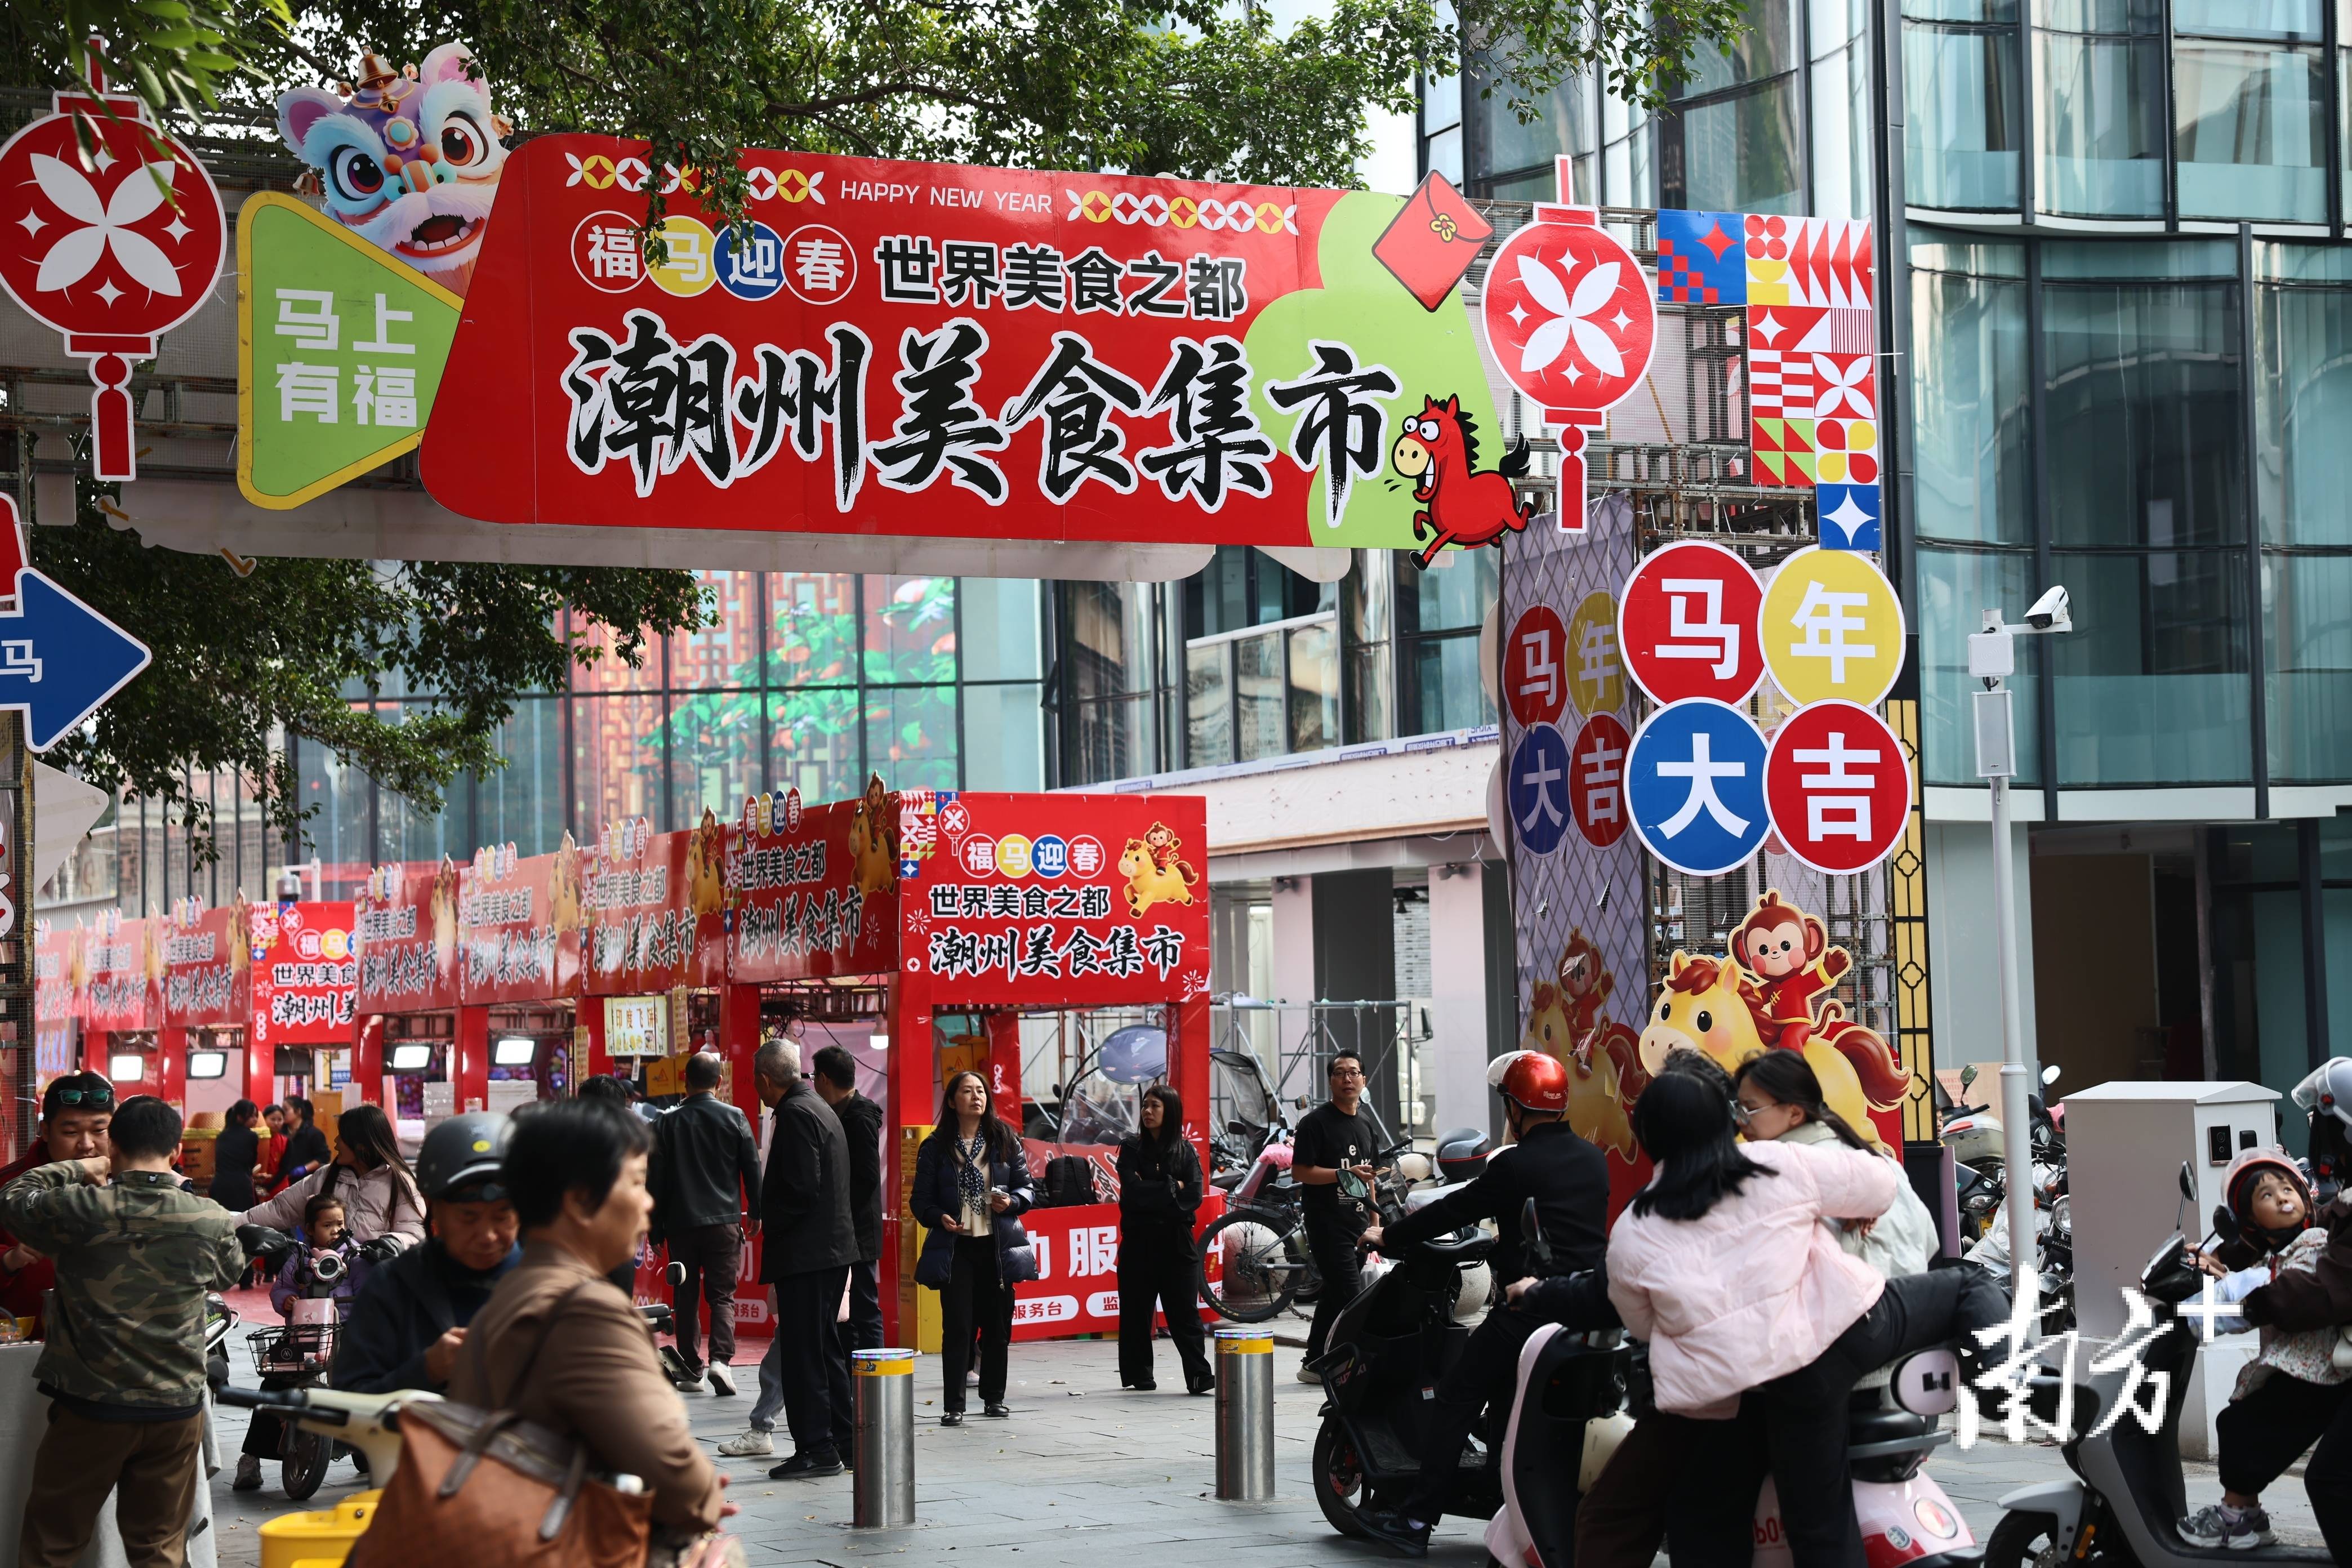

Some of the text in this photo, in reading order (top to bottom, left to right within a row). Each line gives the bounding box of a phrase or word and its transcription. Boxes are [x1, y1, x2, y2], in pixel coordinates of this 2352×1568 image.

[841, 180, 1052, 214] HAPPY NEW YEAR
[587, 224, 846, 293] 福马迎春
[874, 236, 1246, 321] 世界美食之都
[274, 288, 416, 354] 马上
[275, 362, 417, 427] 有福
[563, 310, 1401, 526] 潮州美食集市
[1655, 578, 1876, 684] 马年
[1519, 621, 1619, 707] 马年
[745, 794, 800, 832] 福马迎春
[1522, 738, 1622, 834] 大吉
[1657, 733, 1882, 843] 大吉
[600, 823, 647, 859] 福马迎春
[741, 840, 826, 891] 世界美食之都
[966, 841, 1099, 872] 福马迎春
[470, 886, 532, 927] 世界美食之都
[596, 865, 666, 911] 世界美食之都
[929, 884, 1111, 919] 世界美食之都
[364, 905, 416, 943] 世界美食之都
[593, 907, 697, 978] 潮州美食集市
[738, 885, 863, 965] 潮州美食集市
[929, 924, 1185, 982] 潮州美食集市
[363, 941, 438, 1000] 潮州美食集市
[469, 925, 556, 991] 潮州美食集市
